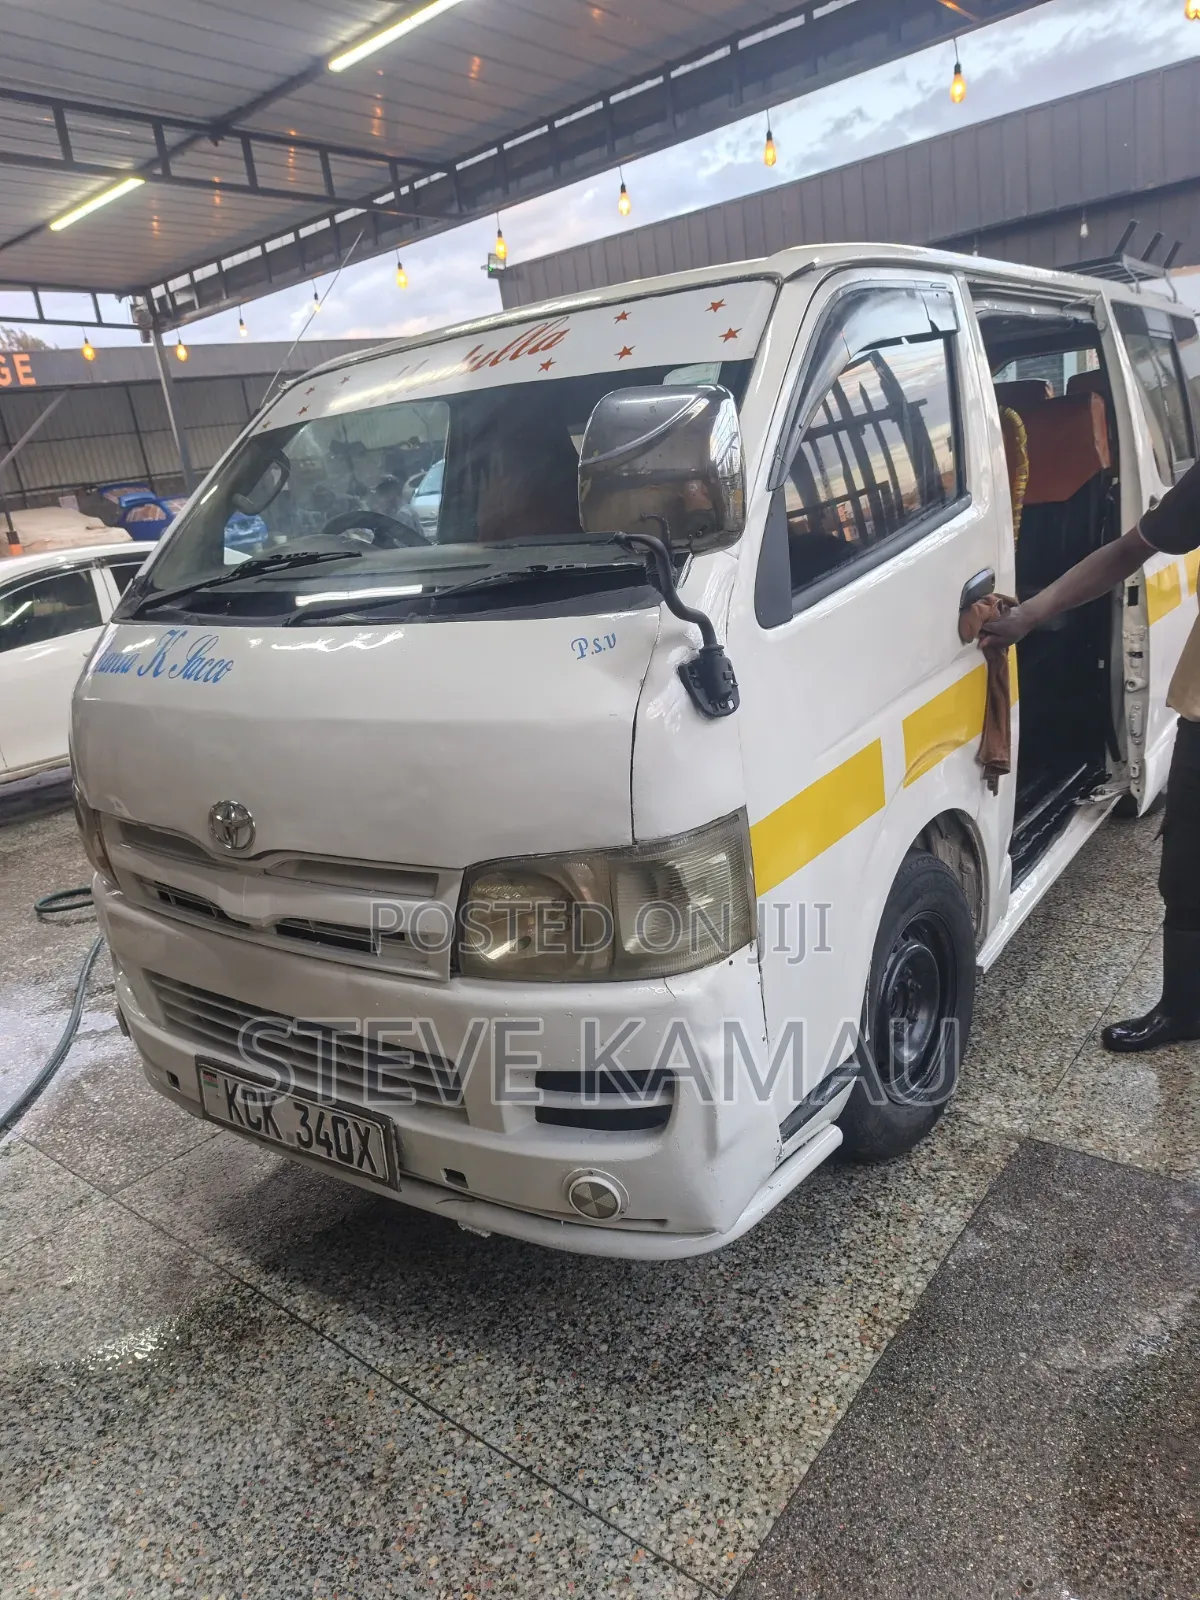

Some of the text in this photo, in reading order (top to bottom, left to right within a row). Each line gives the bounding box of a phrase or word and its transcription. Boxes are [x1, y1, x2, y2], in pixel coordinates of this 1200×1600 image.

[168, 635, 234, 683] Sacco
[224, 1078, 378, 1174] KCK 340X
